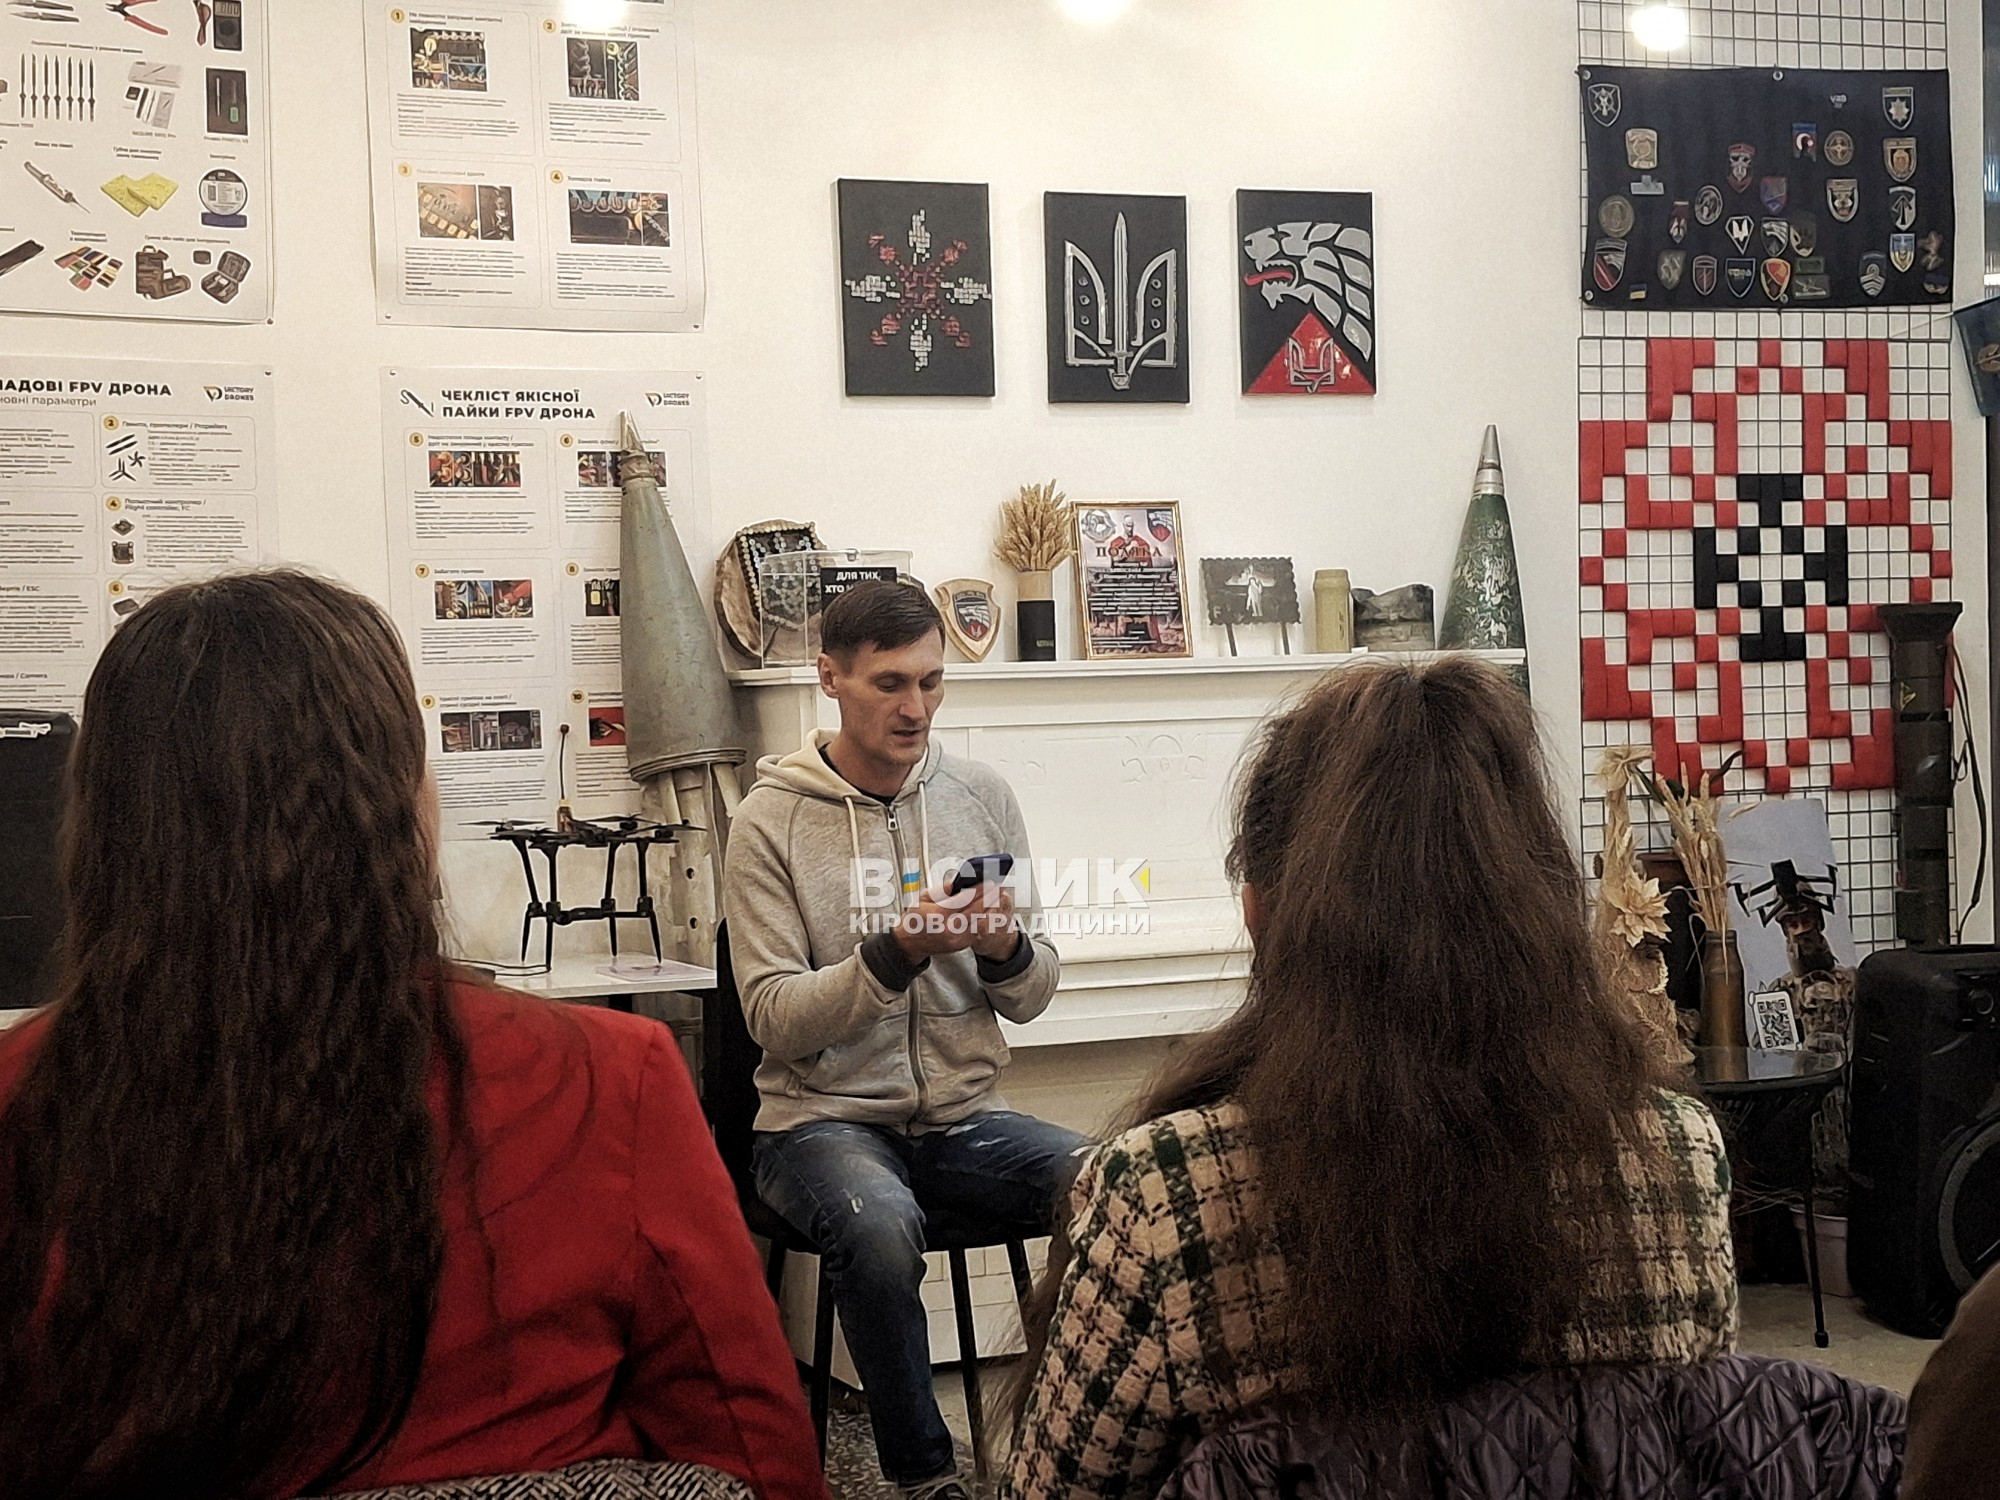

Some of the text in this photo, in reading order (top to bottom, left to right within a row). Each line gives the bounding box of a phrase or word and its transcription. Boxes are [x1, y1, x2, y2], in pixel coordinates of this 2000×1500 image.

[0, 379, 172, 396] АДОВІ FPV ДРОНА
[441, 389, 580, 403] ЧЕКЛІСТ ЯКІСНОЇ
[32, 397, 97, 408] параметри
[443, 404, 596, 420] ПАЙКИ FPV ДРОНА
[1096, 546, 1163, 558] ПОДЯКА
[836, 571, 858, 581] ДЛЯ
[825, 585, 845, 593] ХТО
